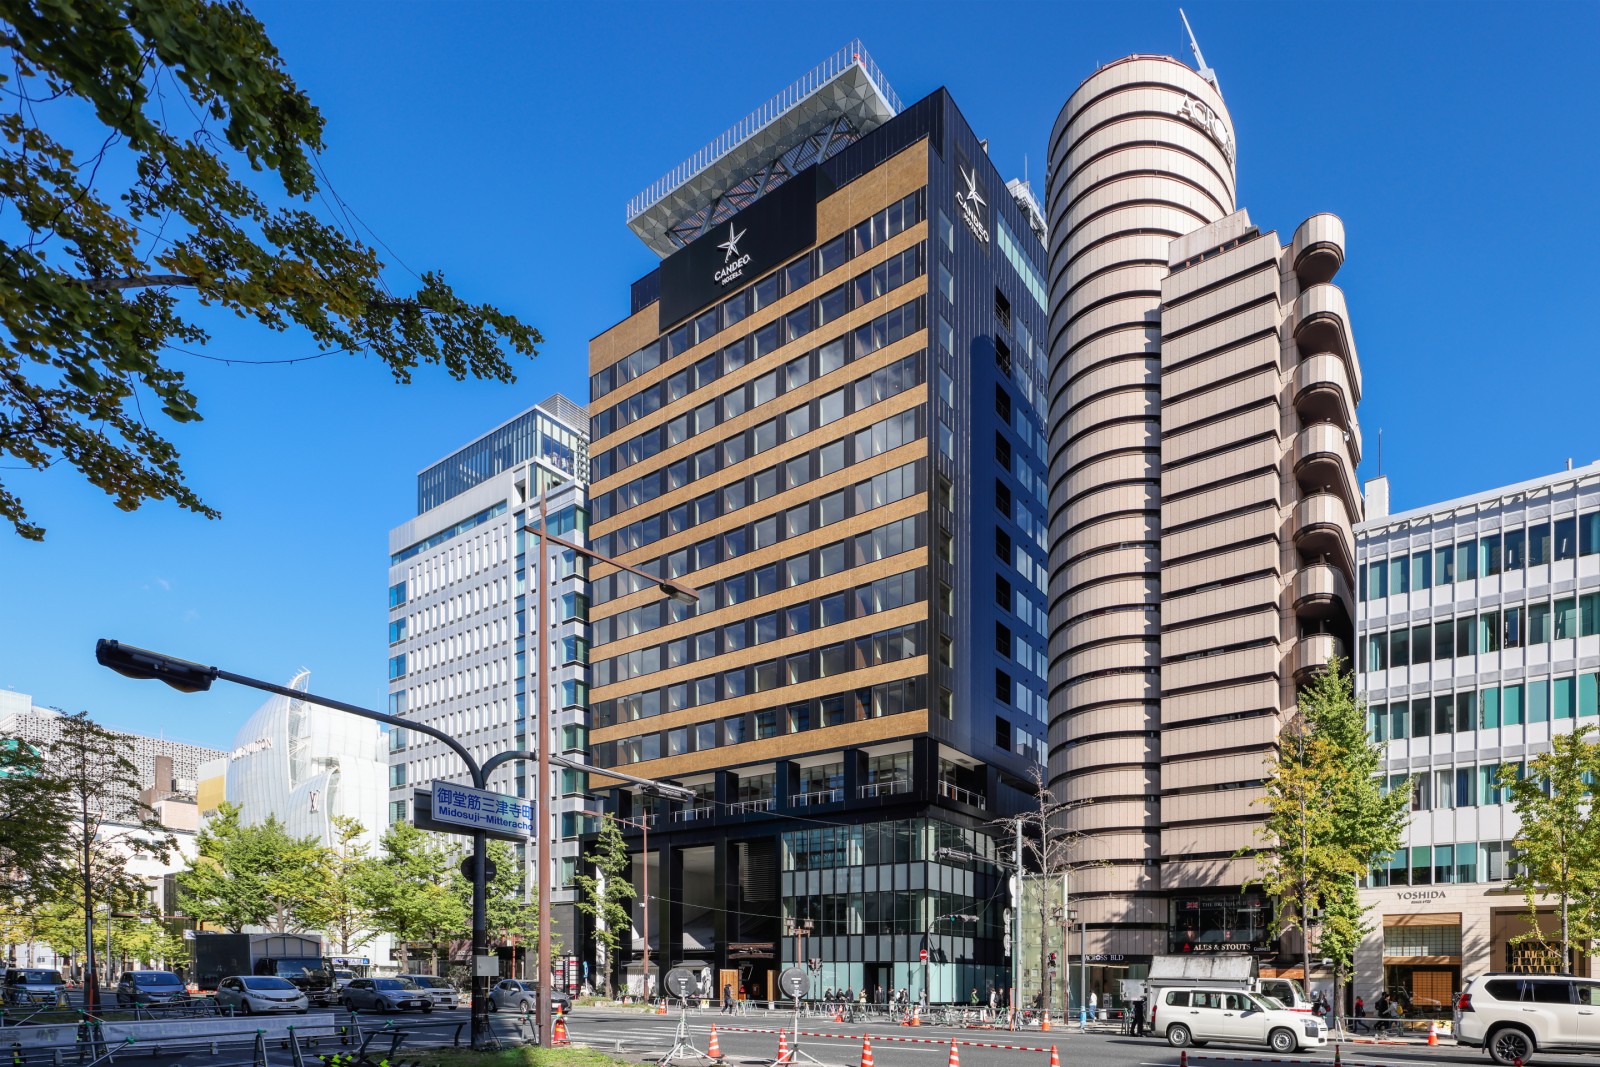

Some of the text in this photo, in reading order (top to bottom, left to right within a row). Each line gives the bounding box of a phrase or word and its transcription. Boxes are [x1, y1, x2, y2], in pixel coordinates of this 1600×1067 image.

[955, 191, 990, 243] CANDEO
[714, 254, 751, 281] CANDEO
[722, 269, 743, 286] HOTELS
[437, 787, 534, 821] 御堂筋三津寺町
[1397, 891, 1446, 900] YOSHIDA
